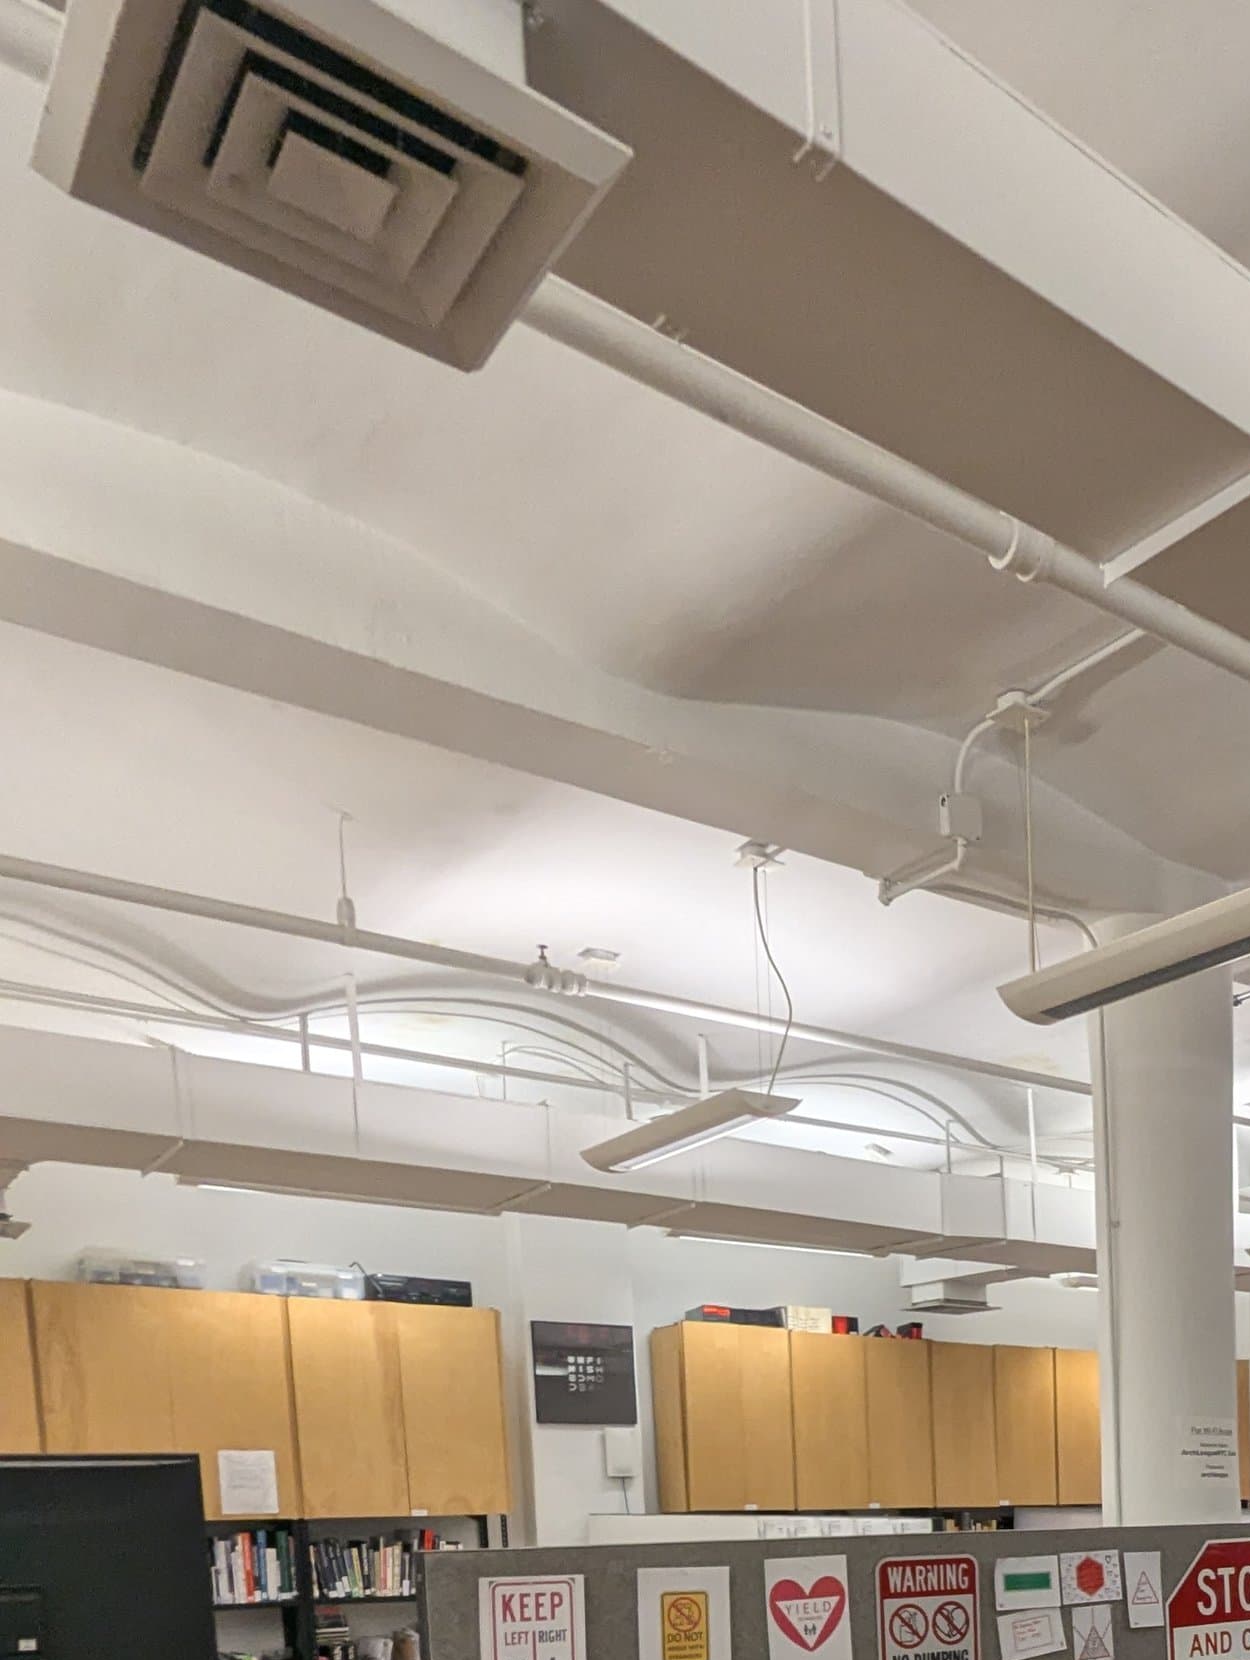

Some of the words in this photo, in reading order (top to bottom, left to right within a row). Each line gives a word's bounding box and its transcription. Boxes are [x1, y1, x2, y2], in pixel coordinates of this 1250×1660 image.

[887, 1563, 969, 1593] WARNING
[502, 1591, 563, 1624] KEEP
[784, 1600, 832, 1615] YIELD
[504, 1631, 529, 1646] LEFT
[538, 1629, 568, 1644] RIGHT
[667, 1633, 682, 1643] DO
[684, 1631, 703, 1642] NOT
[1189, 1630, 1232, 1658] AND
